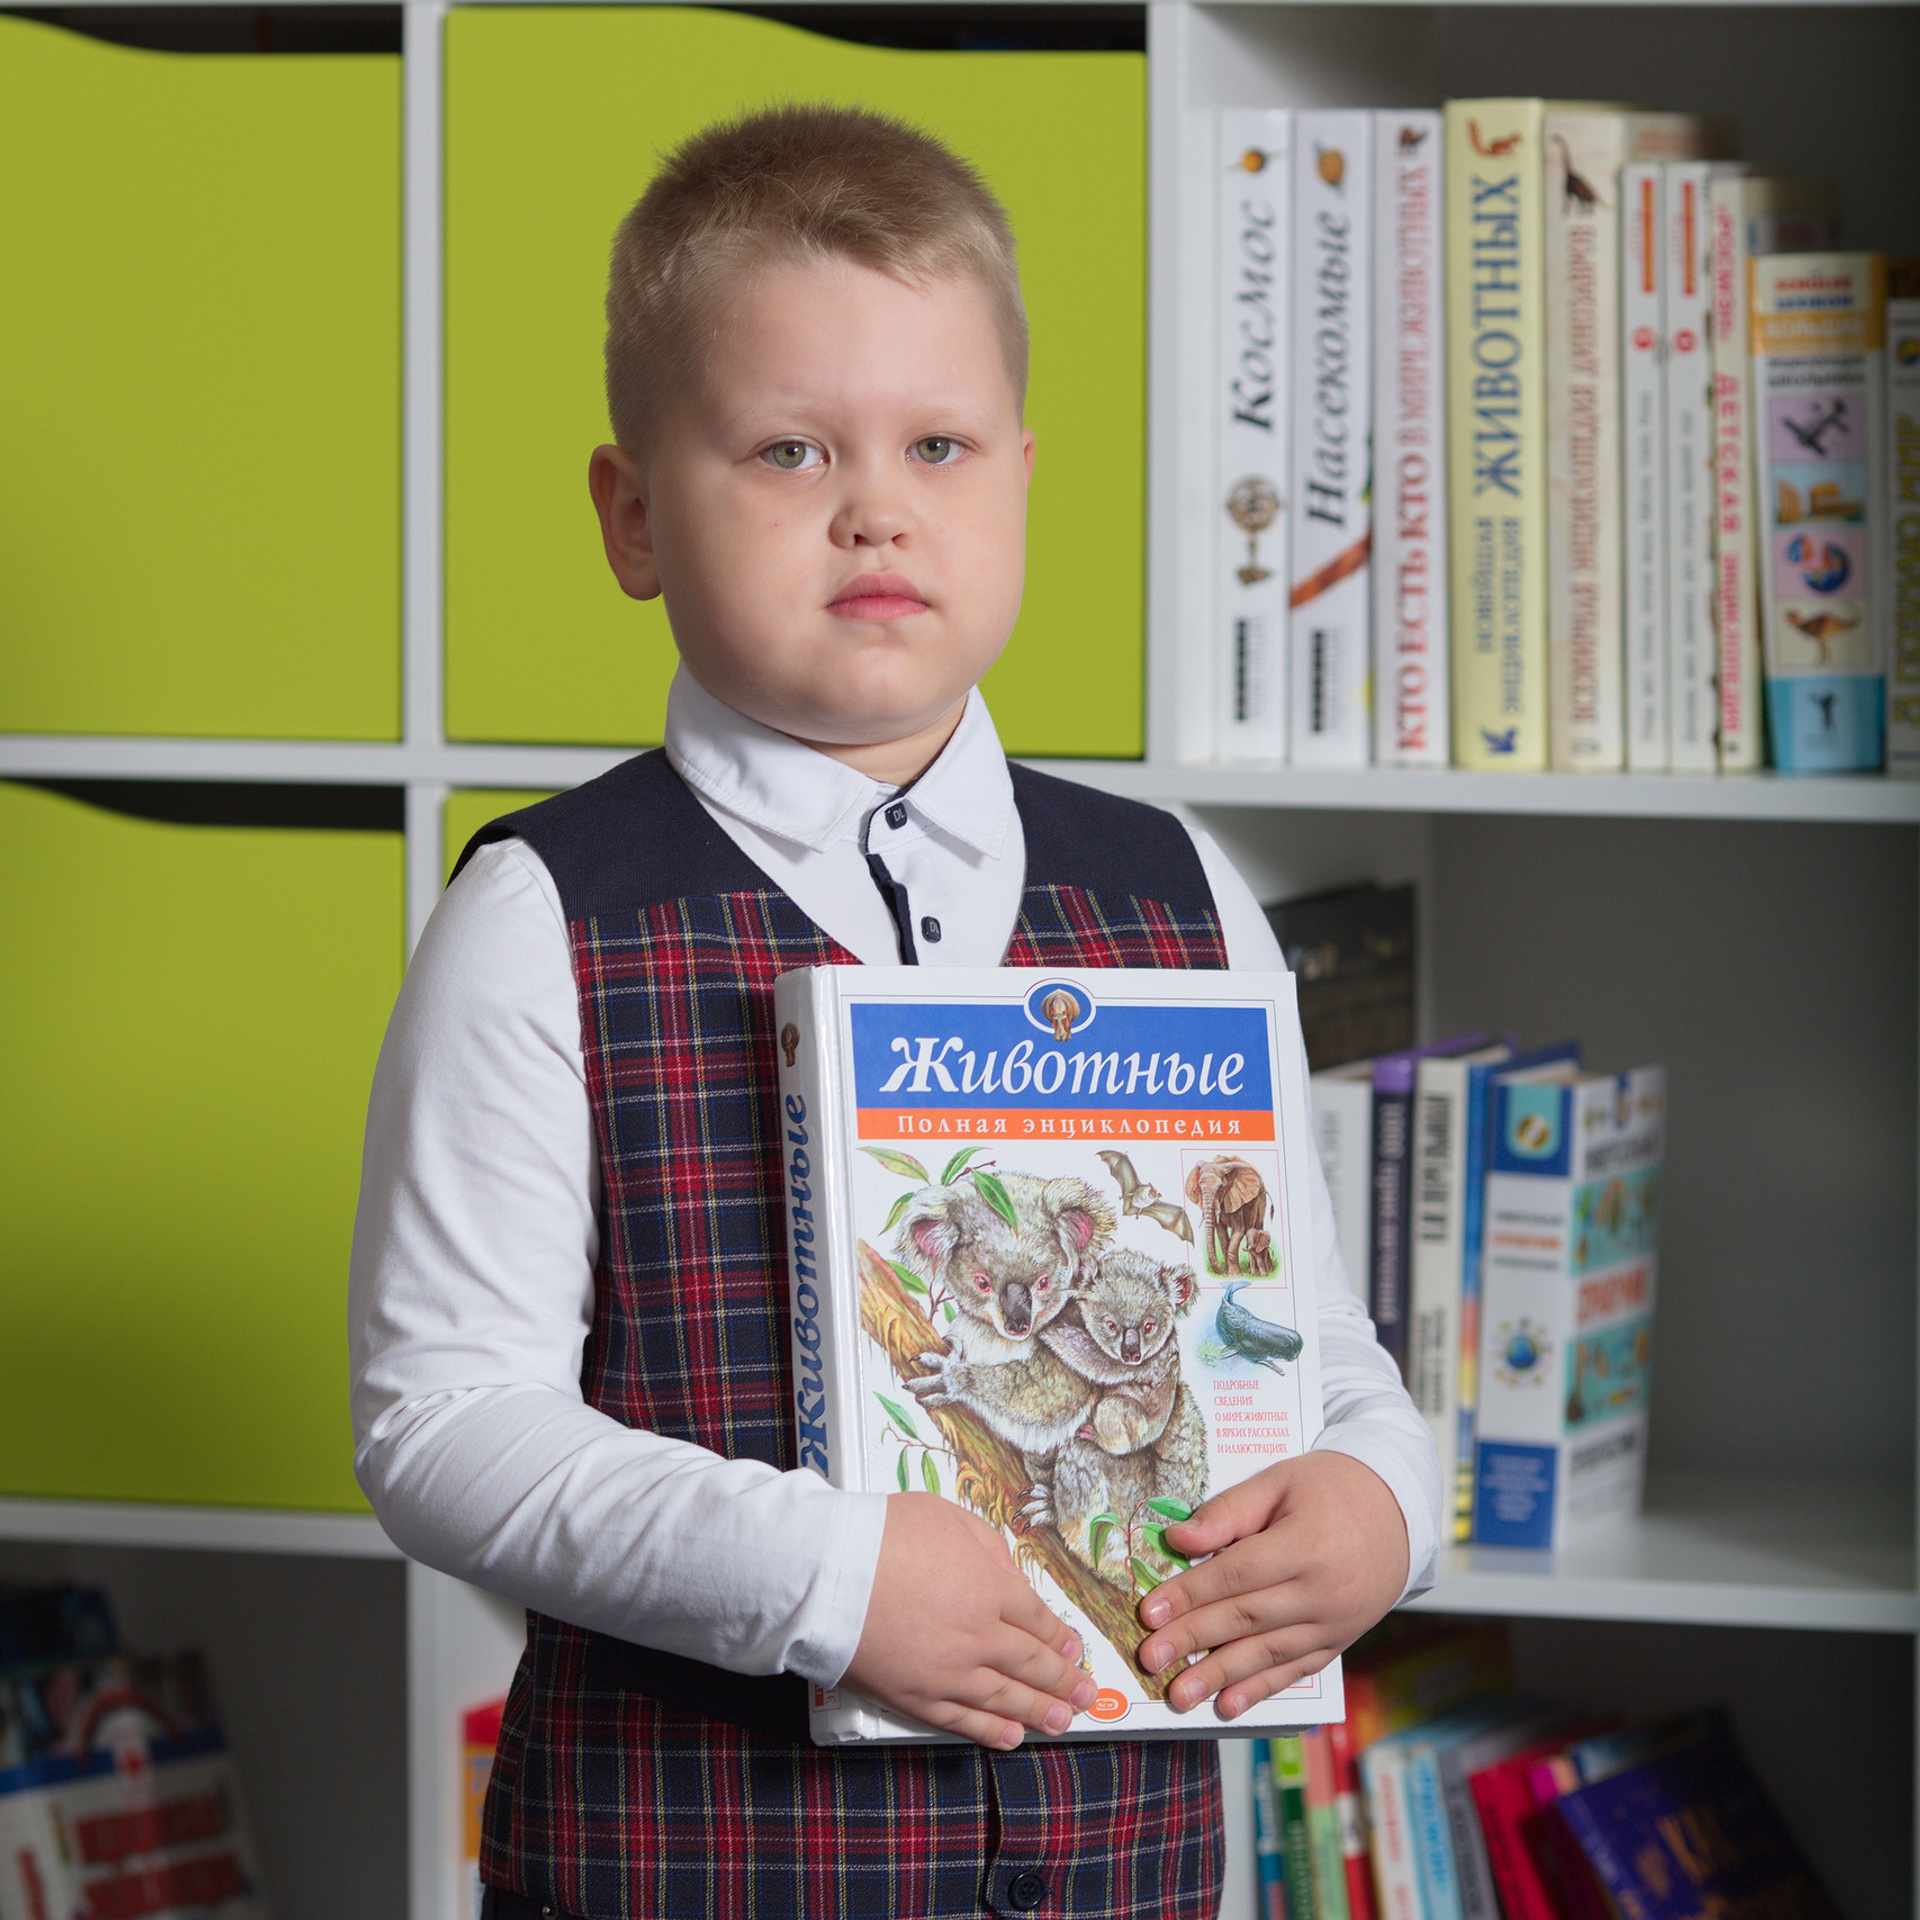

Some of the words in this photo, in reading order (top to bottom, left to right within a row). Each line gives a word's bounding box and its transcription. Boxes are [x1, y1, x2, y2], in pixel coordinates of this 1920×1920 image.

[1393, 165, 1430, 340] ЖИВОТНЫХ
[1229, 199, 1277, 436] Космос
[1469, 173, 1523, 500] ЖИВОТНЫХ
[1303, 209, 1353, 530] Насекомые
[1715, 371, 1741, 535] ДЕТСКАЯ
[1395, 455, 1430, 540] КТО
[1395, 549, 1430, 654] ЕСТЬ
[1395, 666, 1430, 752] КТО
[879, 1036, 1245, 1096] Животные
[897, 1114, 1008, 1135] Полная
[1022, 1117, 1242, 1139] энциклопедия
[784, 1093, 830, 1478] Животные
[1213, 1380, 1259, 1391] ПОДРОБНЫЕ
[1214, 1396, 1253, 1406] СВЕДЕНИЯ
[1215, 1412, 1221, 1422] О
[1222, 1412, 1243, 1422] МИРЕ
[1244, 1412, 1288, 1422] ЖИВОТНЫХ
[1216, 1428, 1221, 1438] В
[1222, 1428, 1247, 1438] ЯРКИХ
[1247, 1427, 1290, 1438] РАССКАЗАХ
[1217, 1444, 1224, 1454] И
[1224, 1443, 1288, 1456] ИЛЛЮСТРАЦИЯХ
